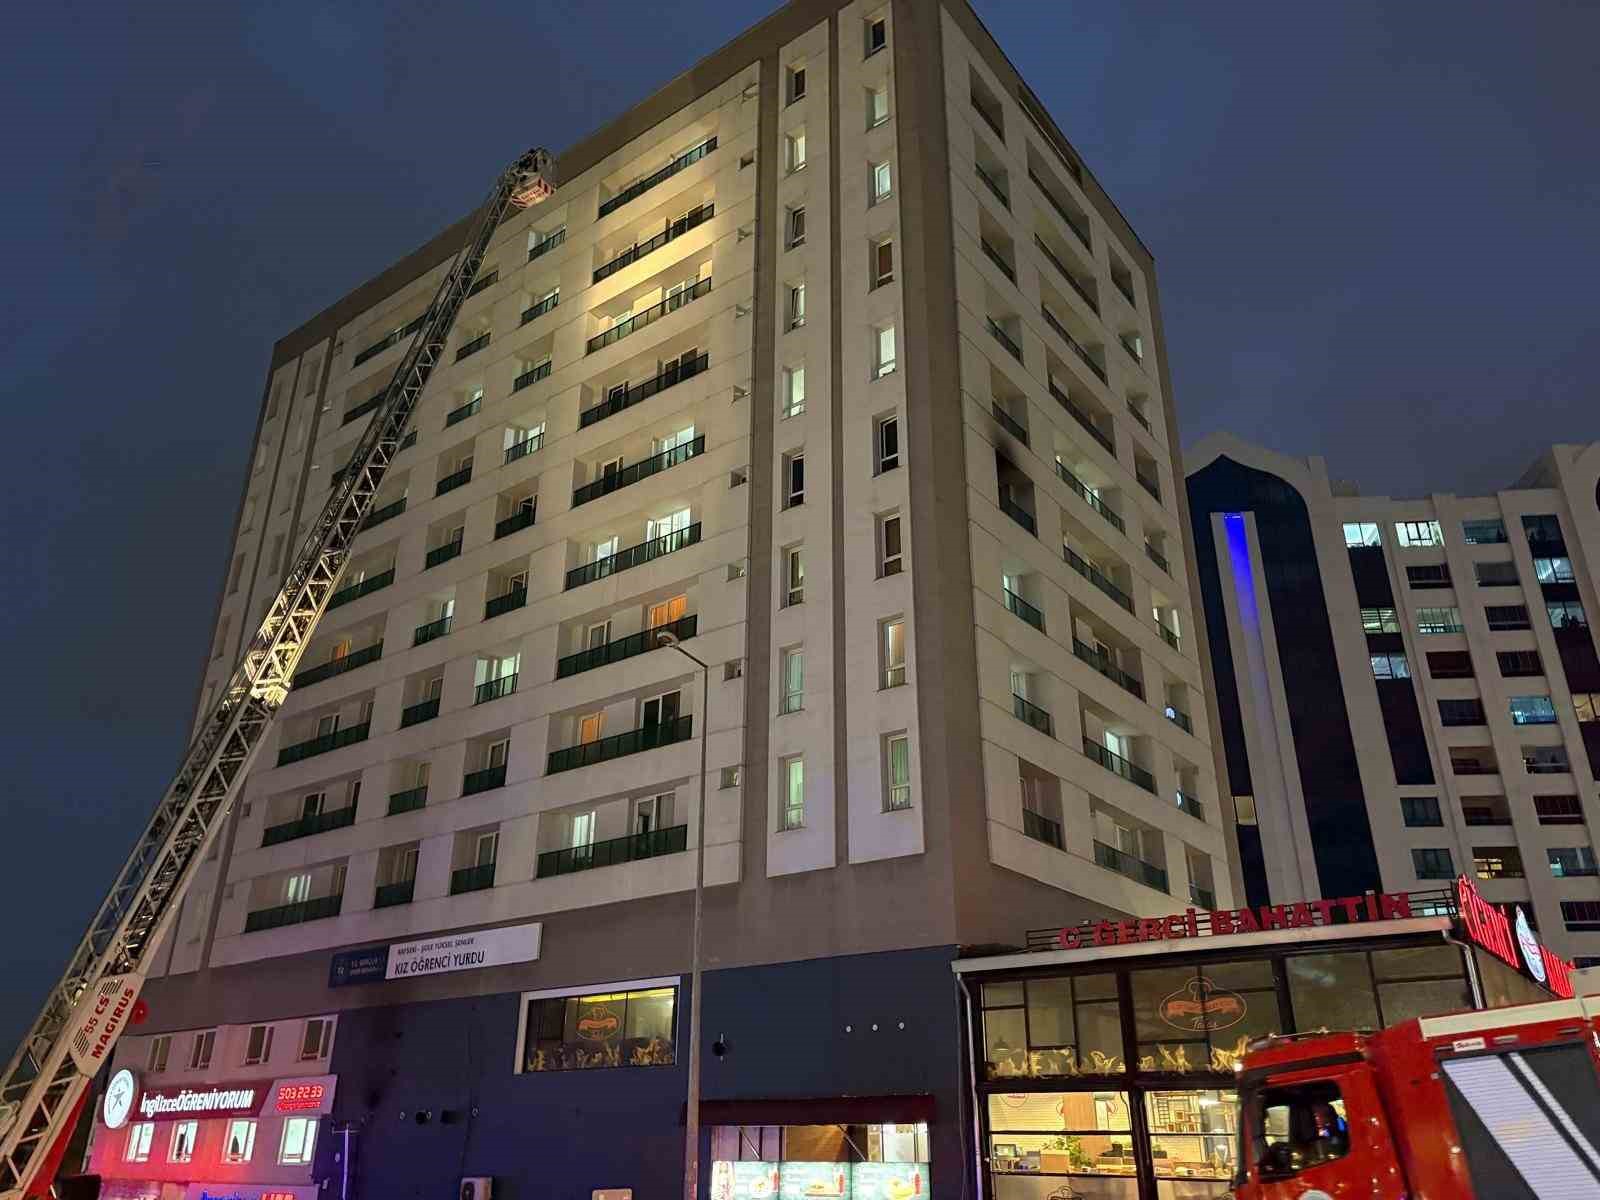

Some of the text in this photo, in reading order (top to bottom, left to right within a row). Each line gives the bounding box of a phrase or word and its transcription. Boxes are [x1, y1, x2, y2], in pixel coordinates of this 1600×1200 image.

[395, 960, 408, 975] KIZ
[453, 951, 485, 968] YURDU
[84, 1016, 98, 1034] 55
[91, 988, 134, 1059] MAGIRUS
